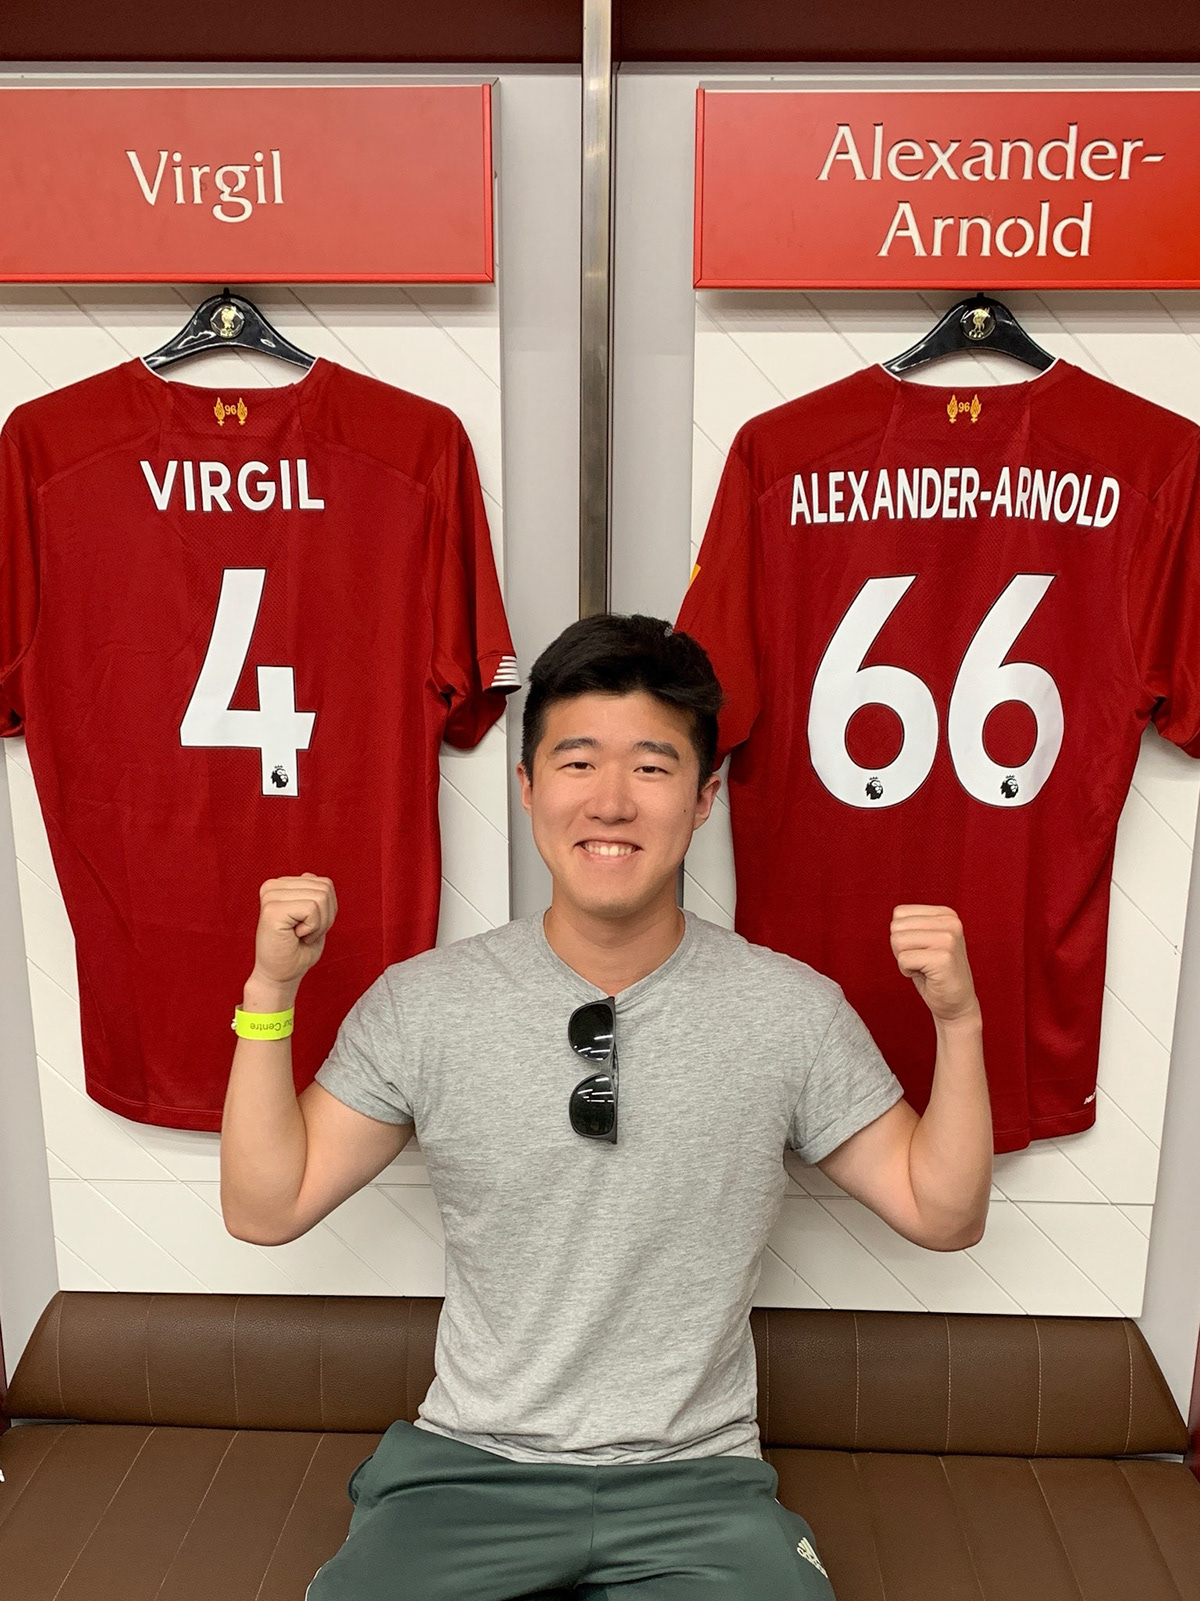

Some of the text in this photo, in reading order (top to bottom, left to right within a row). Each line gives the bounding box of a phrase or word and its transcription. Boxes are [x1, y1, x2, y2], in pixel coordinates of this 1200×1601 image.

[816, 123, 1165, 183] Alexander-
[126, 149, 284, 223] Virgil
[877, 200, 1094, 259] Arnold
[224, 404, 237, 416] 96
[957, 401, 971, 414] 96
[139, 458, 325, 513] VIRGIL
[790, 465, 1121, 528] ALEXANDER-ARNOLD
[180, 568, 316, 797] 4
[807, 574, 1065, 808] 66
[249, 1022, 282, 1032] Centre
